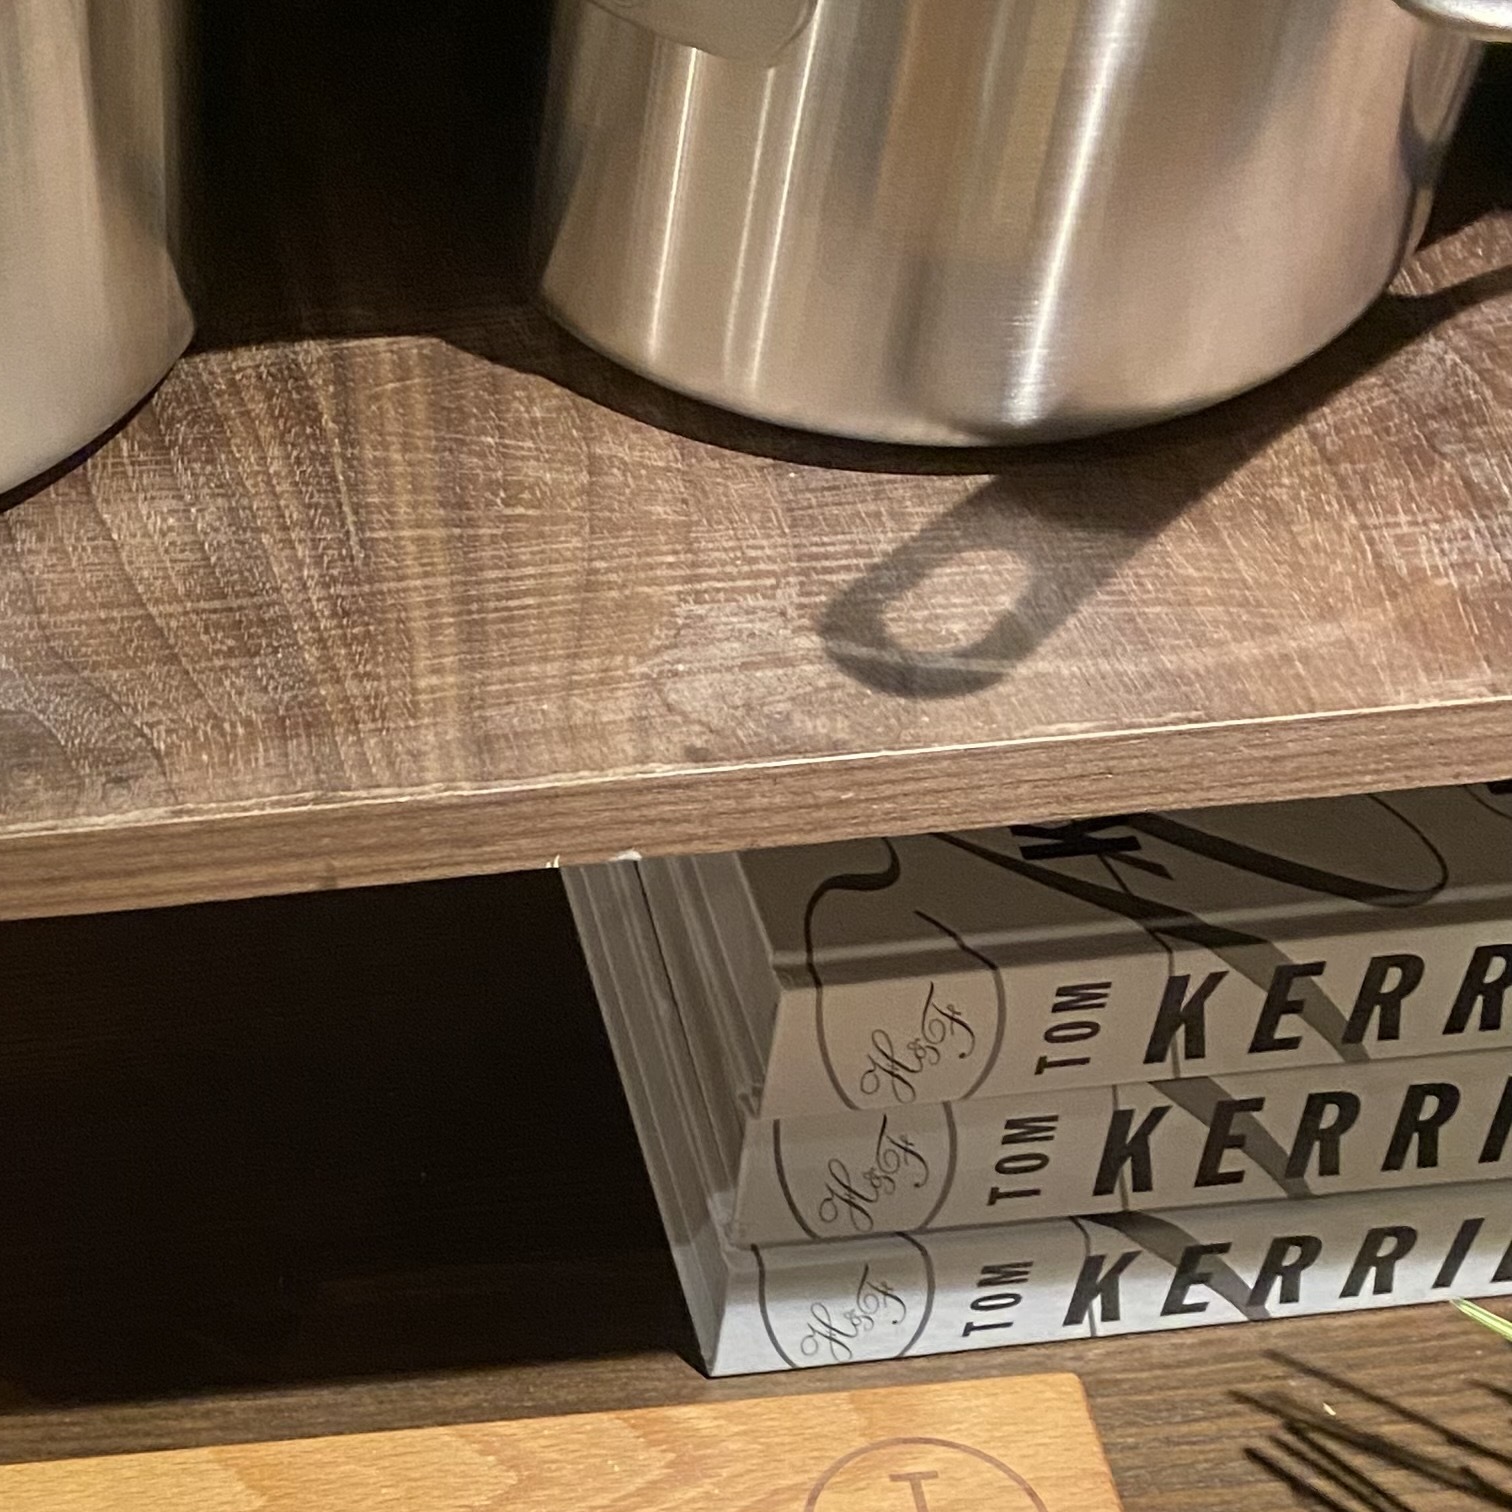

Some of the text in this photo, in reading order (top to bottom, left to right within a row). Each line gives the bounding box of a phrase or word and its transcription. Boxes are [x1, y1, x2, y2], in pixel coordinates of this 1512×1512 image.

[1034, 981, 1112, 1075] TOM
[987, 1115, 1059, 1205] TOM
[962, 1261, 1033, 1337] TOM
[1062, 1218, 1512, 1327] KERRI
